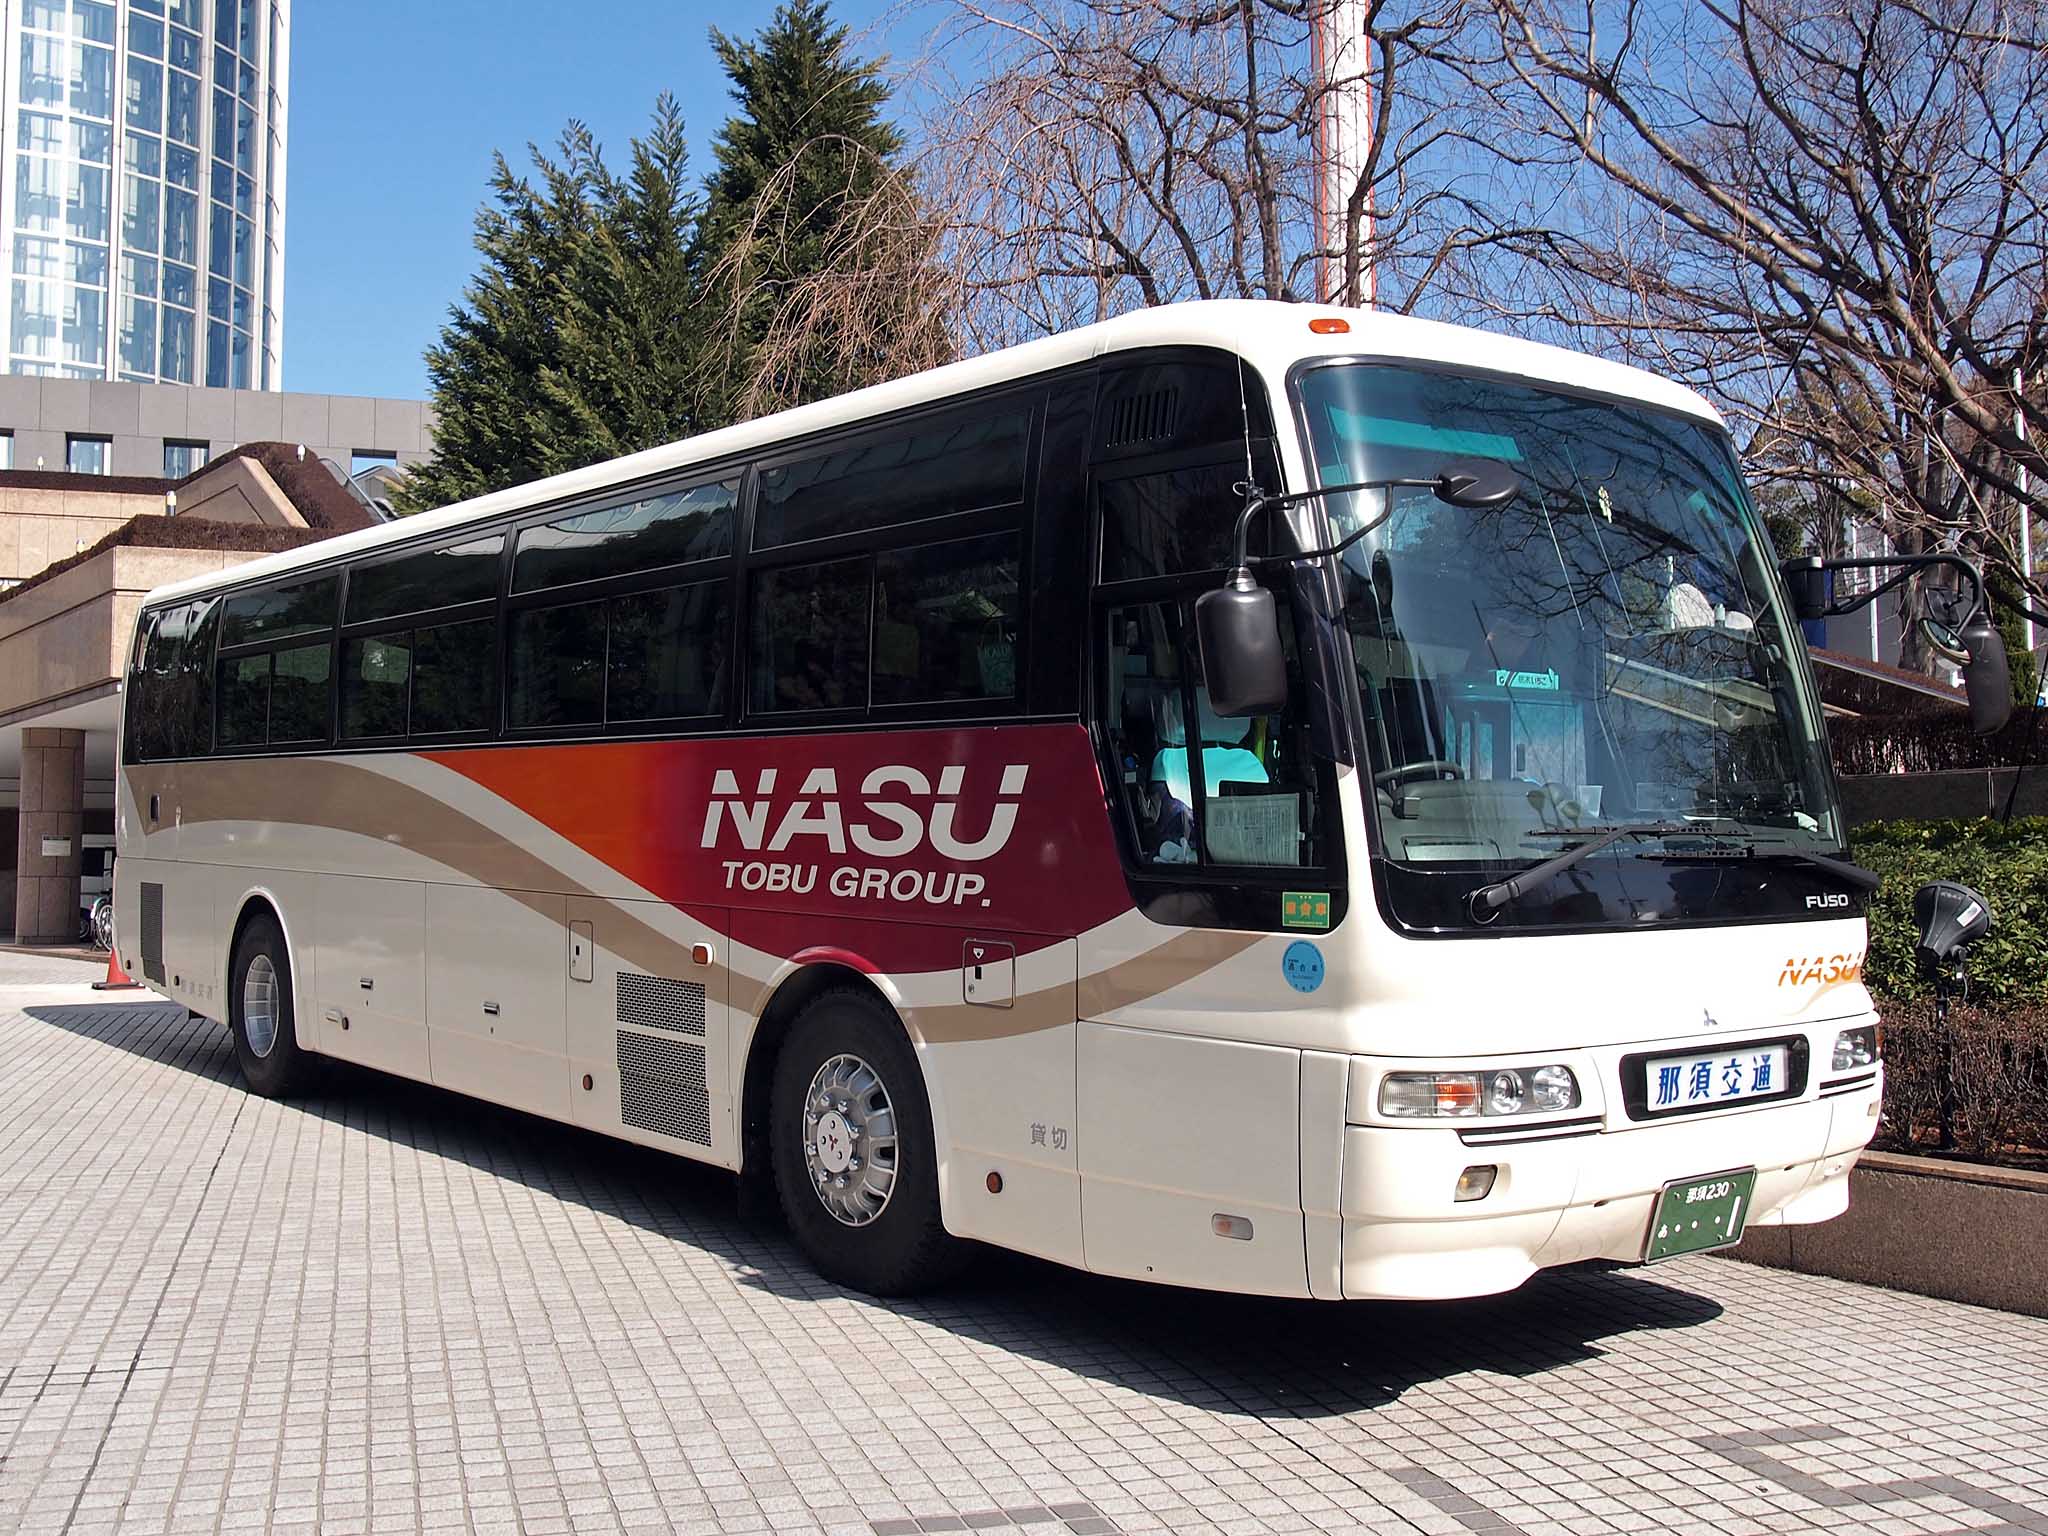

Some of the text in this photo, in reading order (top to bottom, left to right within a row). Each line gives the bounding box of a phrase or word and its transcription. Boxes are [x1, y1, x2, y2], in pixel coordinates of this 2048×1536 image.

[700, 764, 1029, 861] NASU
[722, 861, 991, 907] TOBU GROUP.
[1805, 894, 1849, 908] FUSO
[1778, 951, 1862, 987] NASU
[1655, 1054, 1771, 1105] 那須交通
[1030, 1122, 1067, 1150] 貸切
